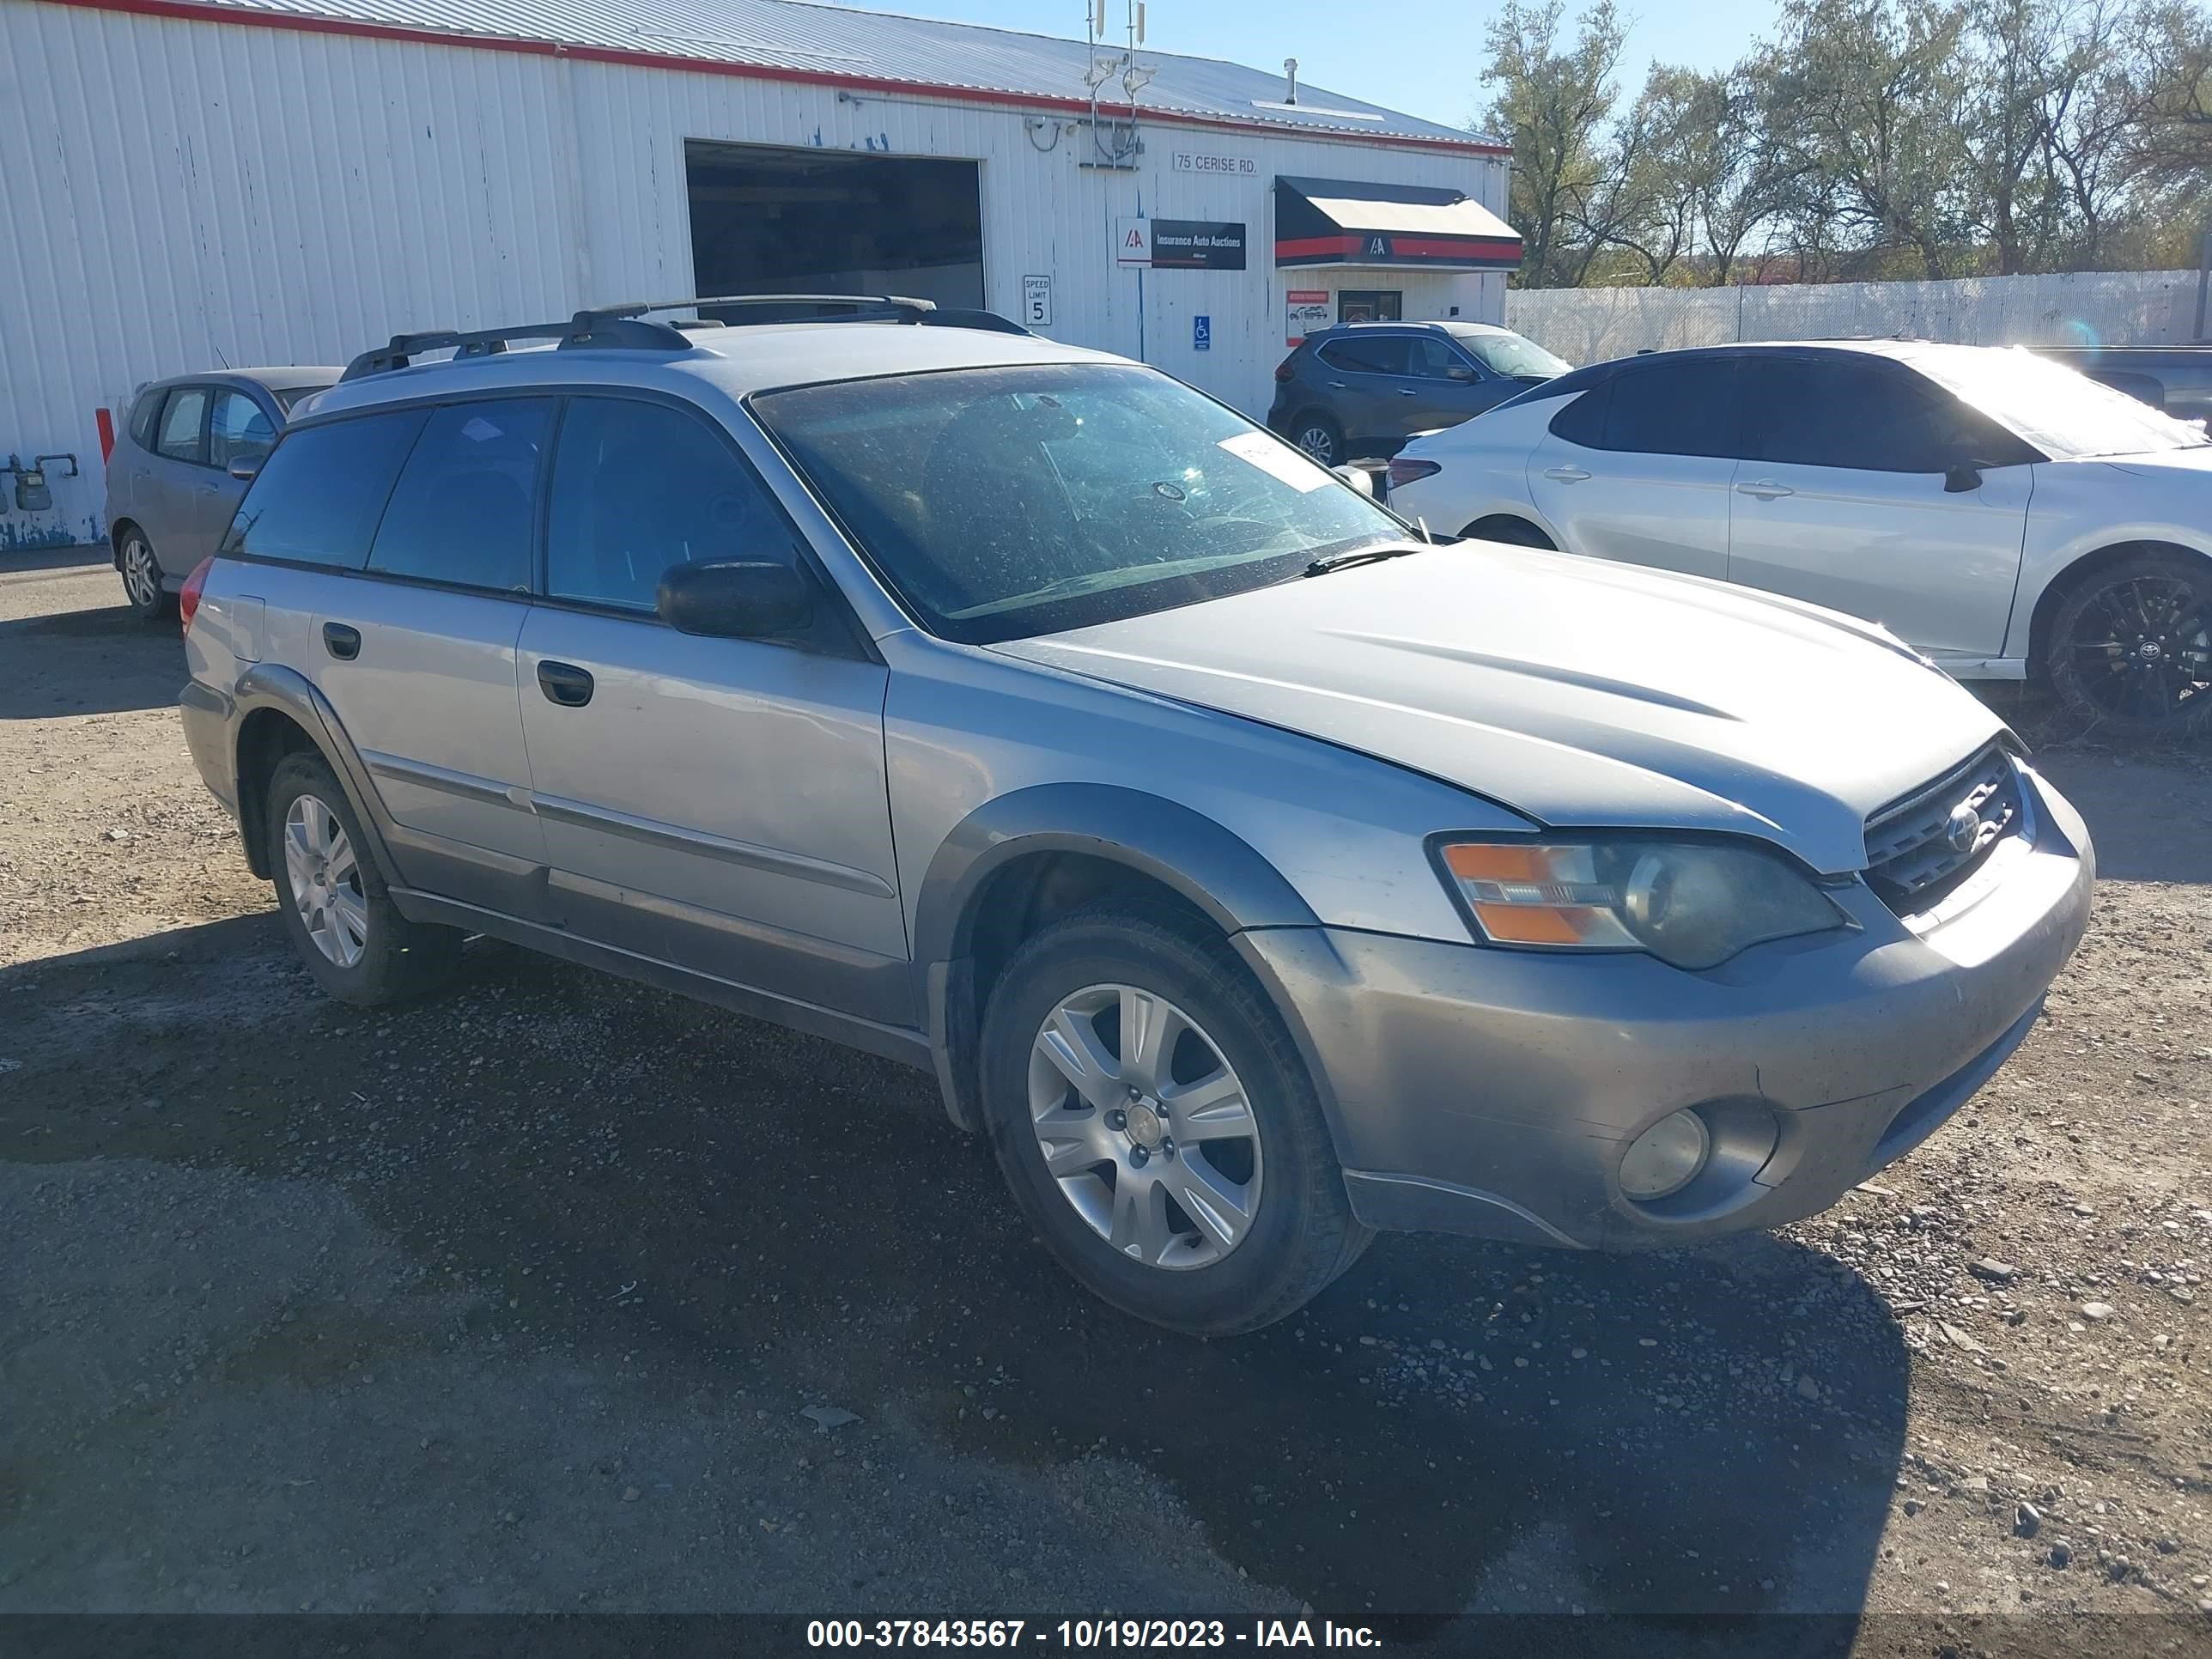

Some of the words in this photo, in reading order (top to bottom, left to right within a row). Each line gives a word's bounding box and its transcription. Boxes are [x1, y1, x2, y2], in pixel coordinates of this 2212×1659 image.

[1177, 155, 1191, 168] 75
[1195, 156, 1235, 172] CERISE
[1239, 160, 1257, 173] RD.
[1157, 234, 1191, 246] Insurance
[1192, 235, 1210, 246] Auto
[1210, 235, 1241, 248] Auctions
[1026, 280, 1048, 289] SPEED
[1033, 301, 1044, 319] 5
